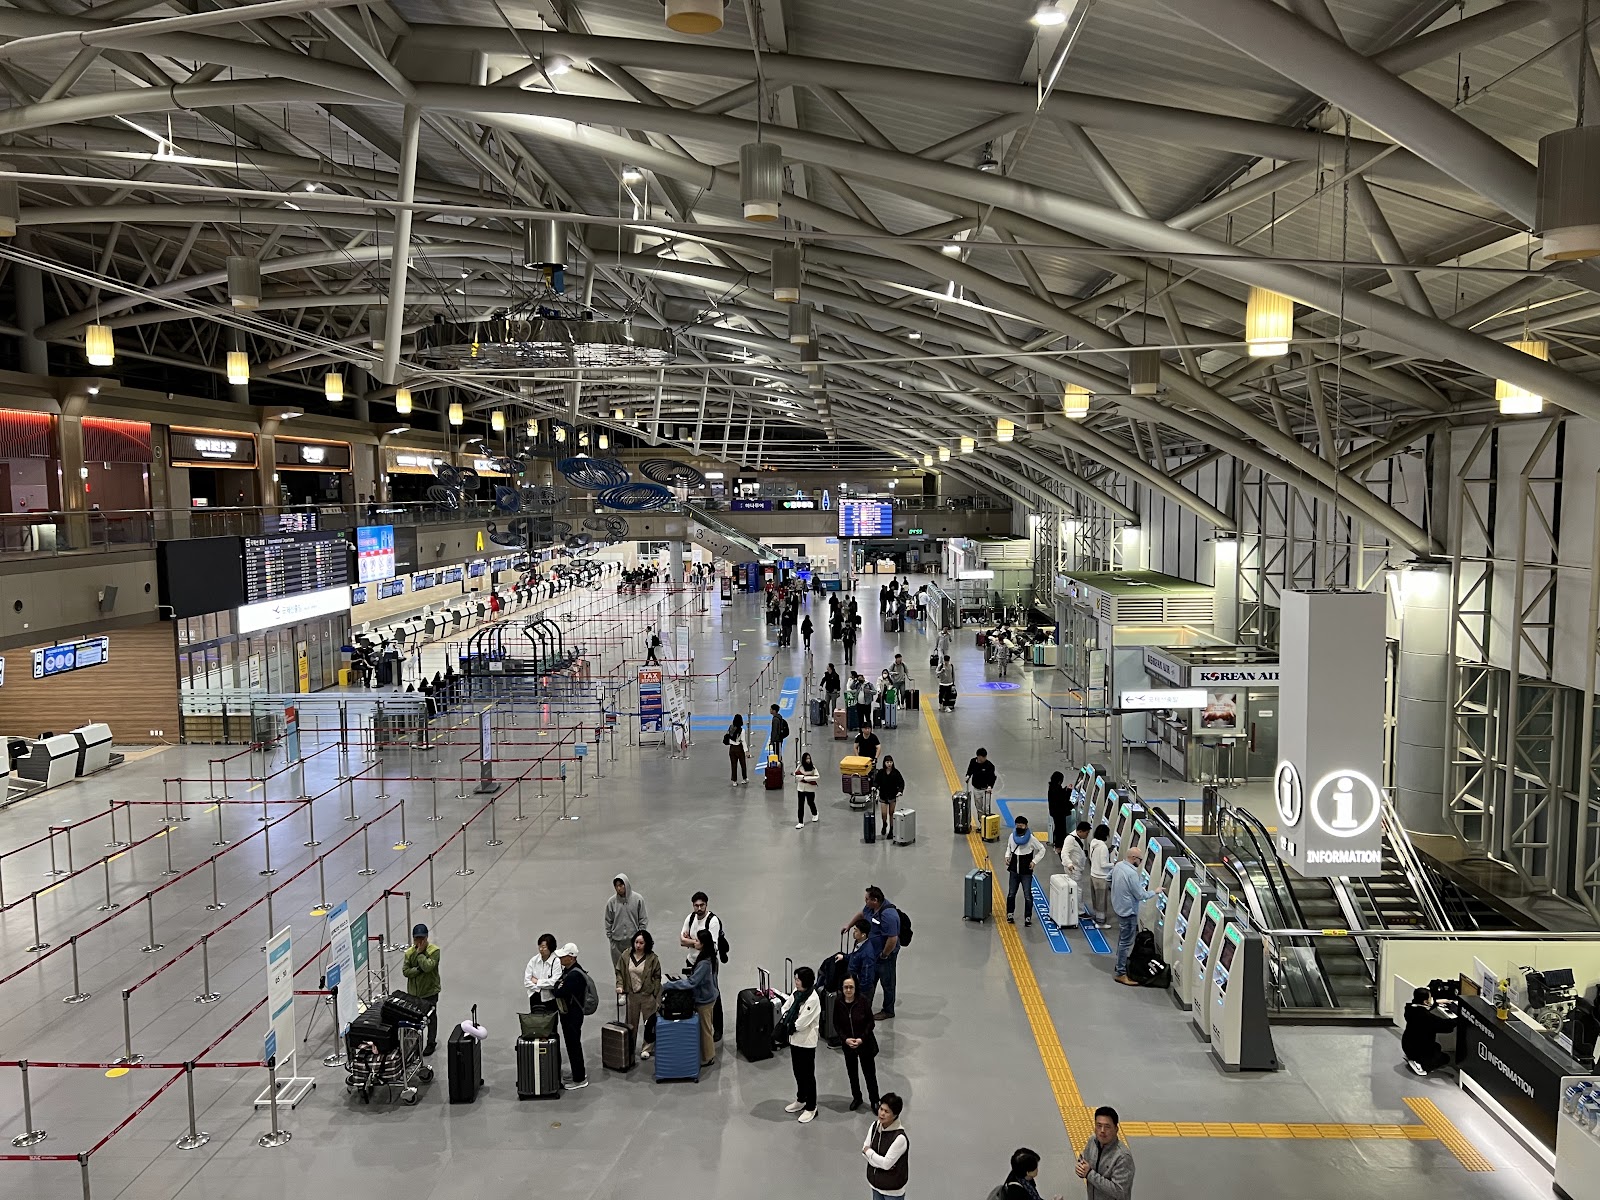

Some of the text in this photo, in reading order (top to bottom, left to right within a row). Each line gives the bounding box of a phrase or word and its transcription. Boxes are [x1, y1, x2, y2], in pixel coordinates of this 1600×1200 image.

[475, 531, 485, 552] A
[35, 653, 42, 663] B
[35, 664, 42, 674] 2
[1200, 671, 1256, 682] KOREAN
[1306, 850, 1381, 863] INFORMATION
[1031, 887, 1060, 936] SELF CHECK-IN
[1487, 1050, 1535, 1098] INFORMATION
